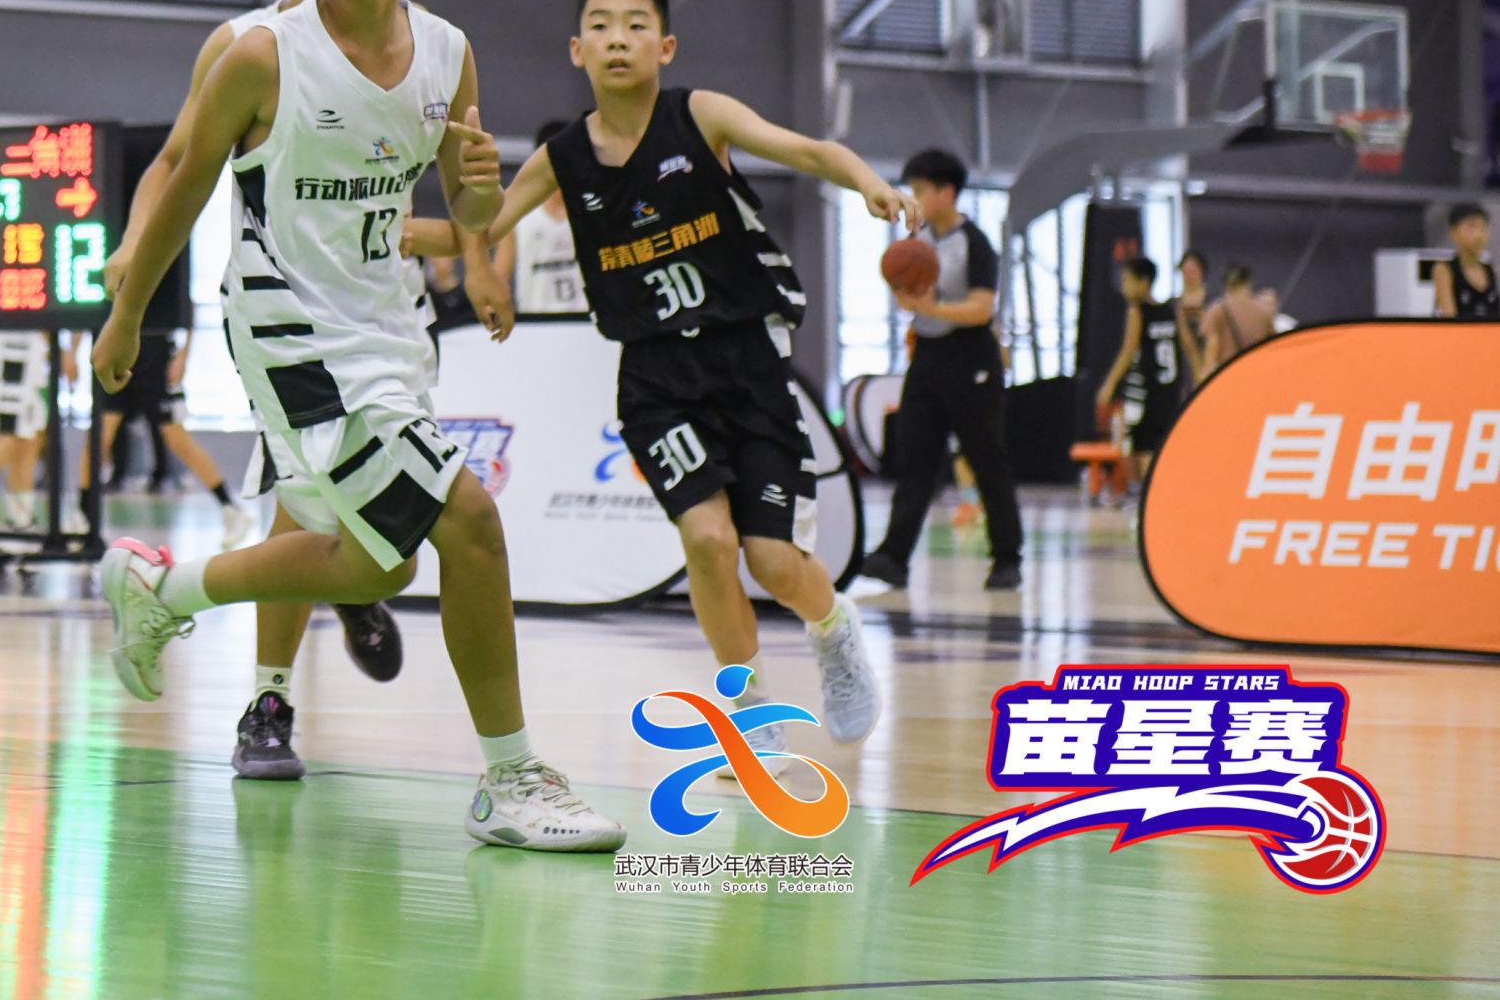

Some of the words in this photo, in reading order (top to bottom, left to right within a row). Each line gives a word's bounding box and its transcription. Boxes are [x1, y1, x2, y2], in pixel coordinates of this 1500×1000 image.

[55, 223, 106, 304] 12
[361, 208, 397, 264] 13
[643, 261, 706, 321] 30
[648, 422, 707, 491] 30
[1228, 520, 1418, 568] FREE
[1433, 524, 1500, 572] TI
